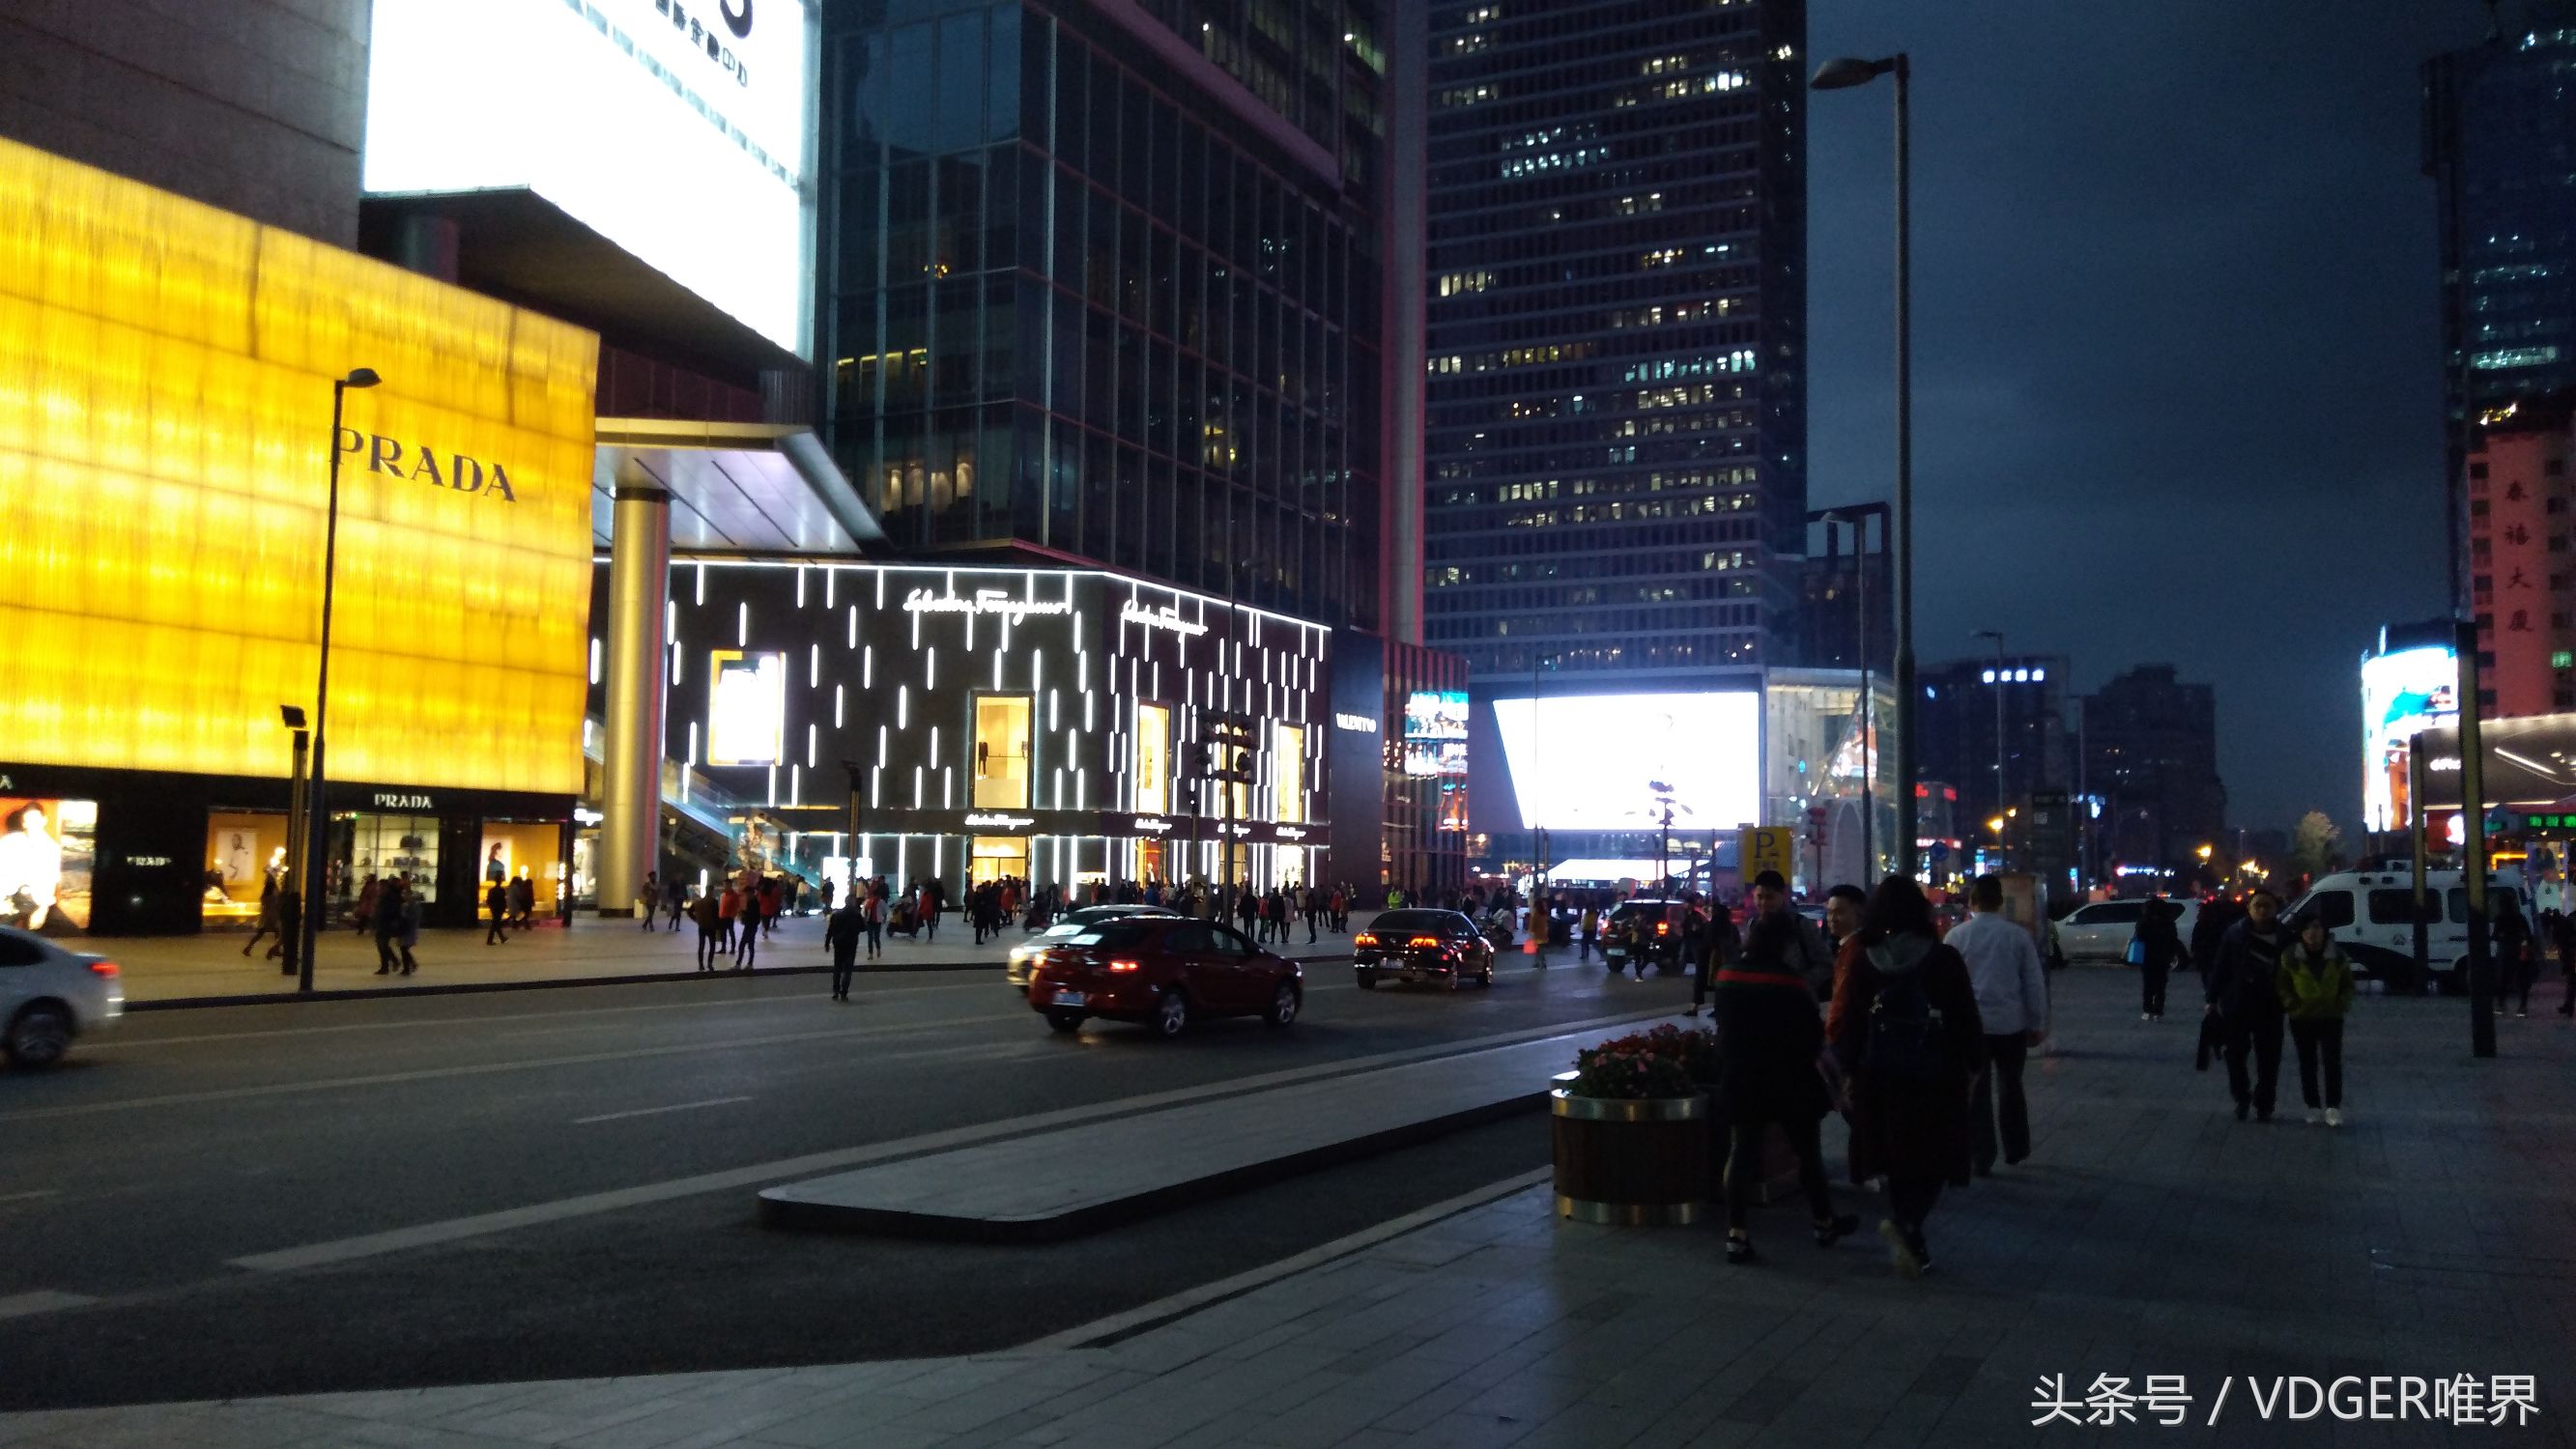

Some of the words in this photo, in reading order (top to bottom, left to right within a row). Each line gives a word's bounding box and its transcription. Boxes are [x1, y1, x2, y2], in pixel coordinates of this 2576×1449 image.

[329, 425, 517, 502] PRADA
[374, 794, 433, 809] PRADA
[1754, 832, 1775, 859] P
